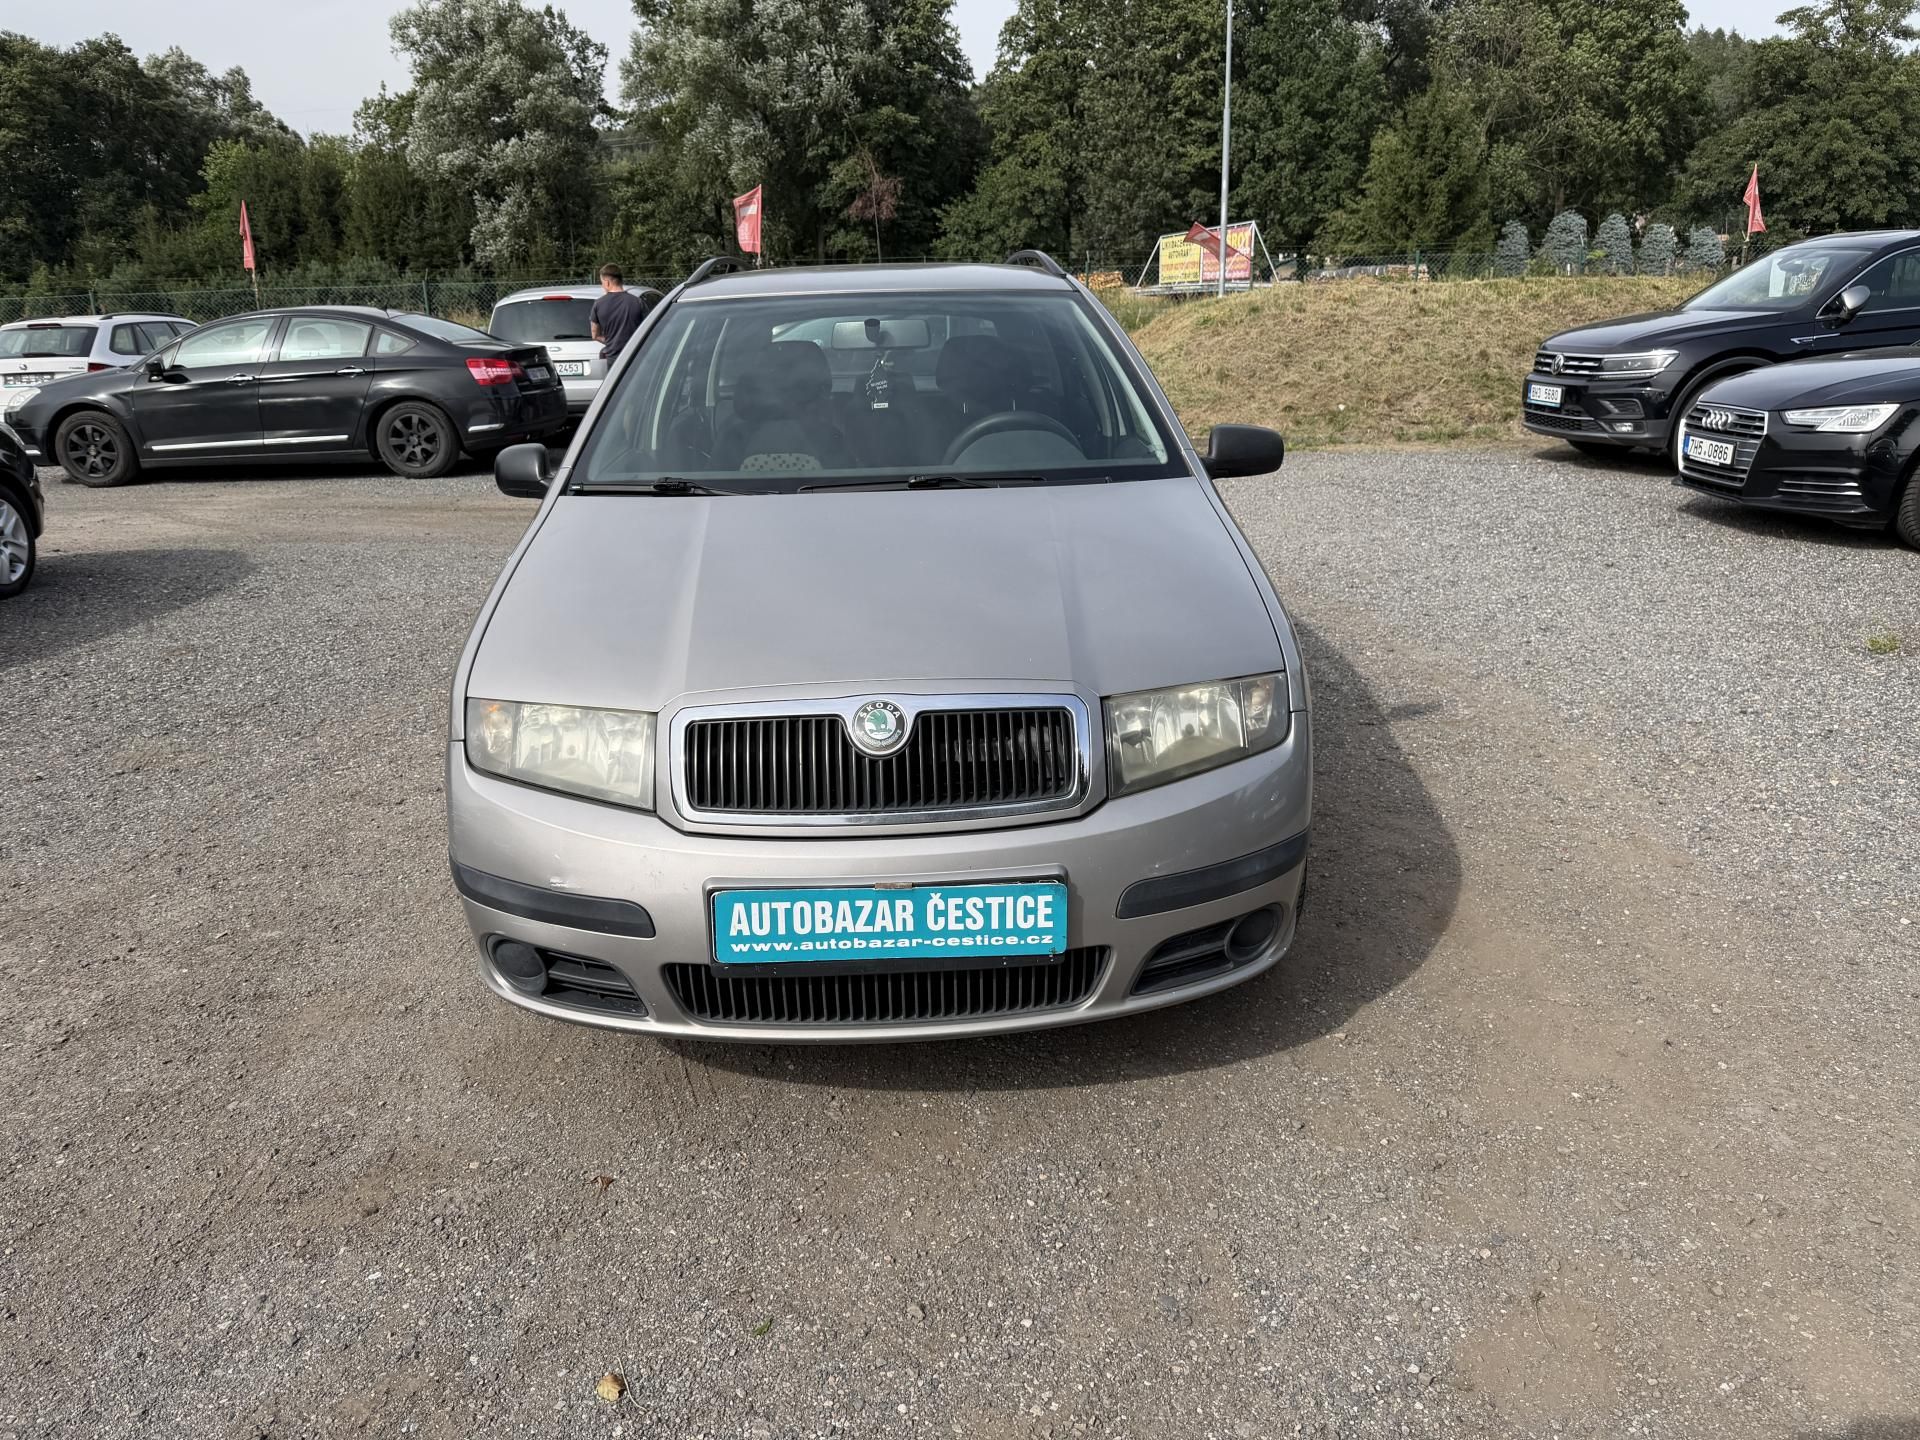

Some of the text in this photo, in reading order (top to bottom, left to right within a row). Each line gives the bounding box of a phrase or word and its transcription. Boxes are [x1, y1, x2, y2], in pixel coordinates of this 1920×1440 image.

[1708, 443, 1729, 461] 0886
[729, 892, 1054, 937] AUTOBAZAR ČESTICE
[730, 935, 1053, 953] www.autobazar-cestice.cz
